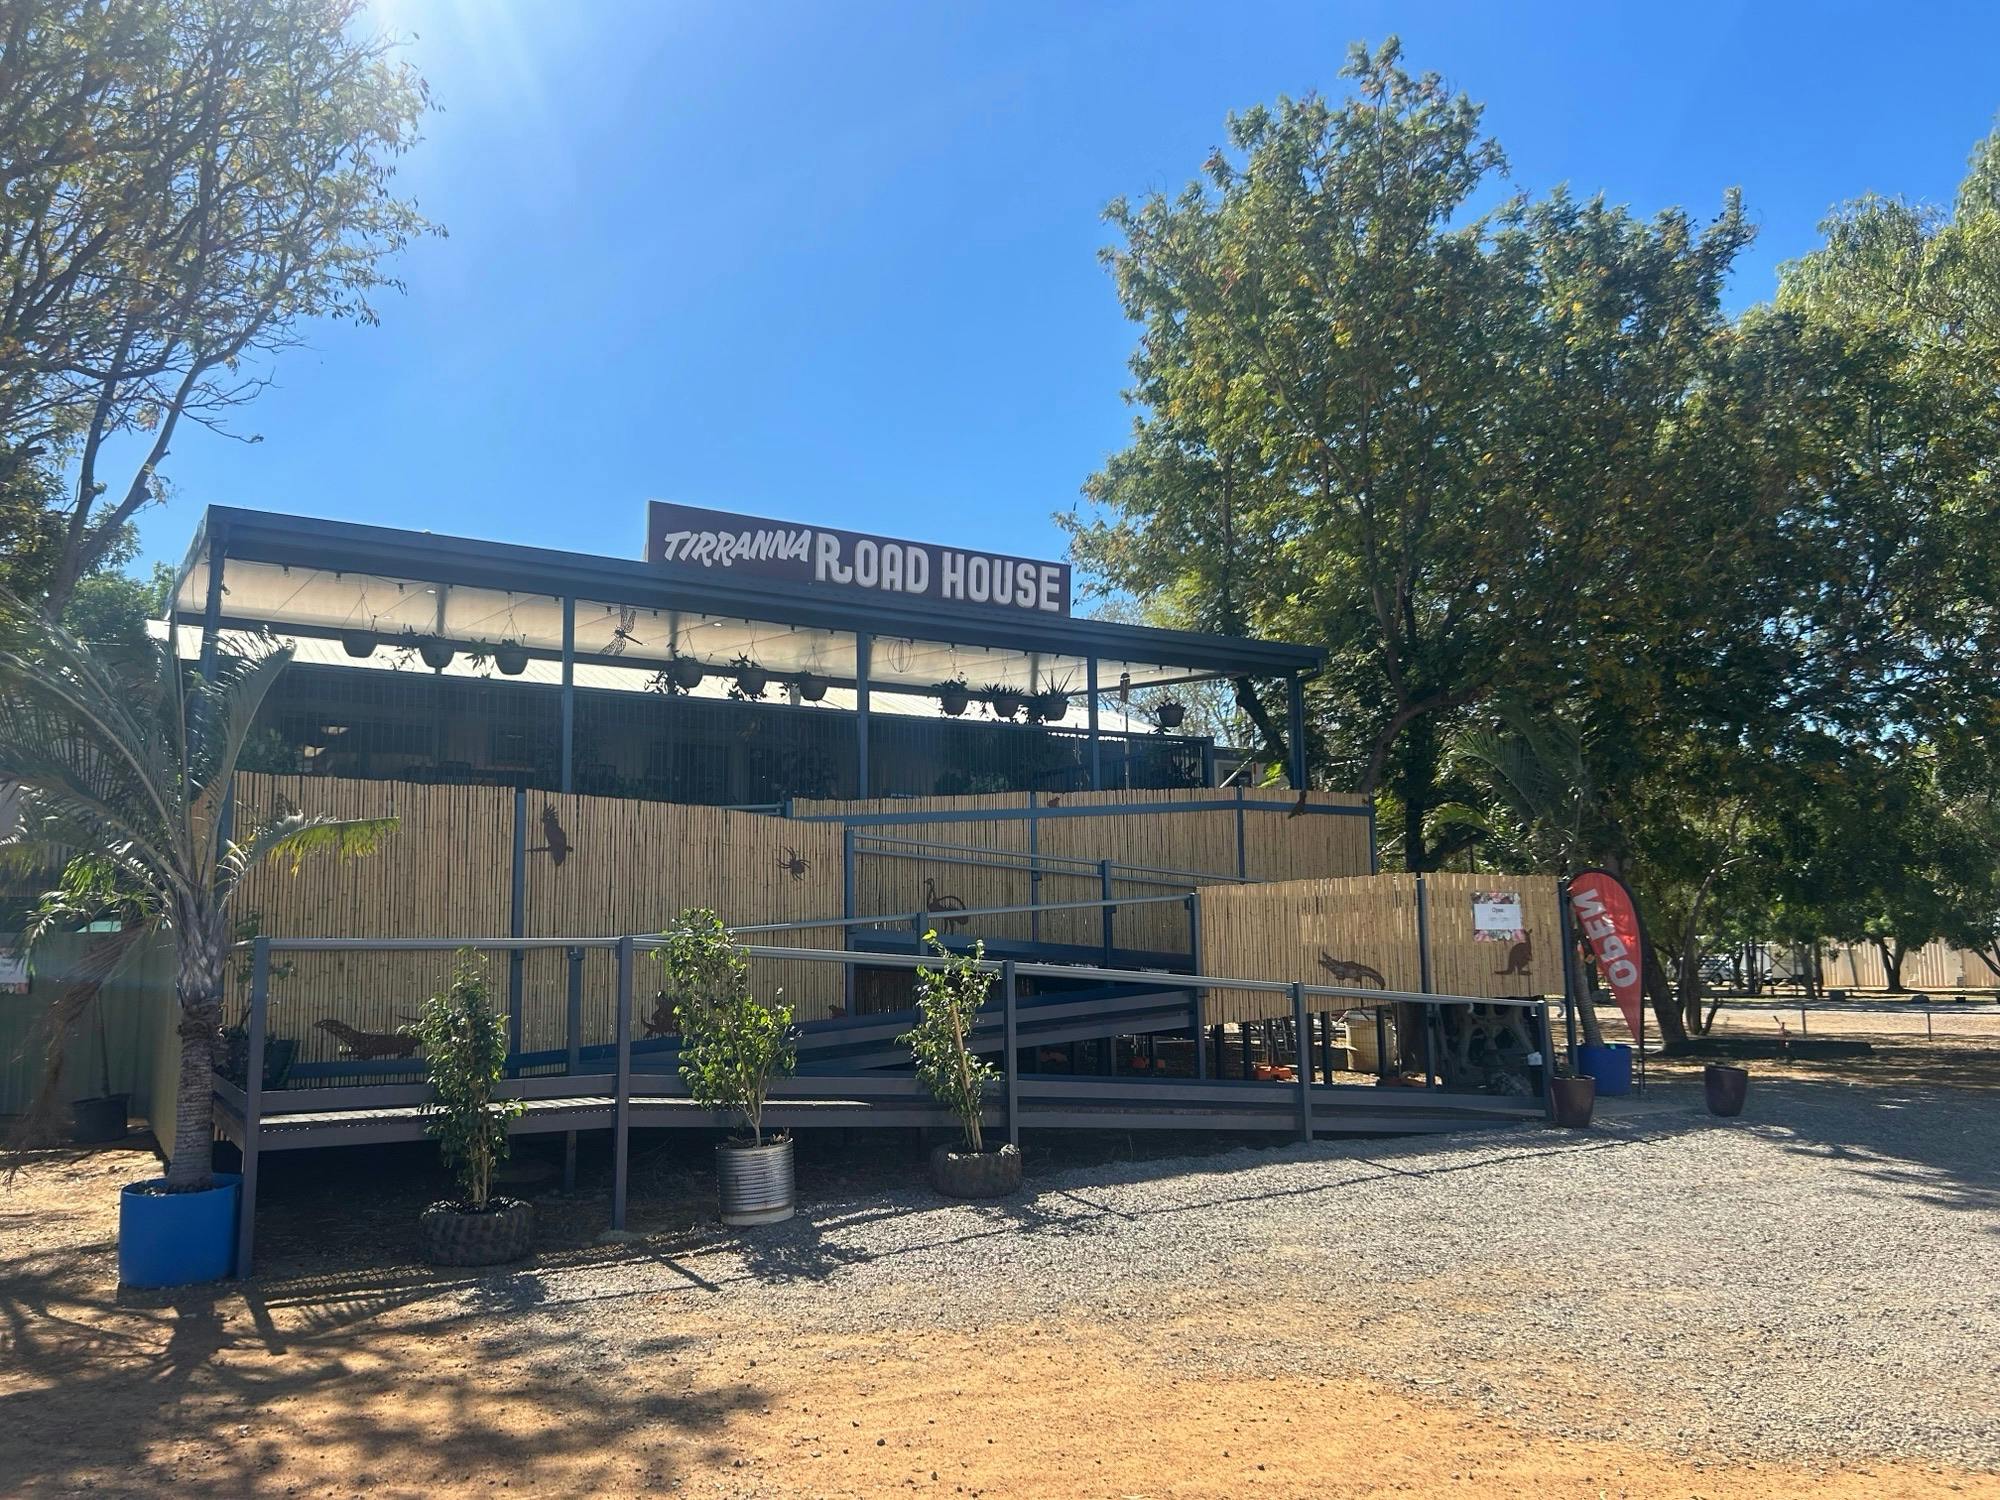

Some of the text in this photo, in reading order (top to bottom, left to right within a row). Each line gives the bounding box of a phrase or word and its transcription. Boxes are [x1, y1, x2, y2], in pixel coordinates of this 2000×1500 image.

[664, 530, 1060, 611] TIRRANNA ROAD HOUSE
